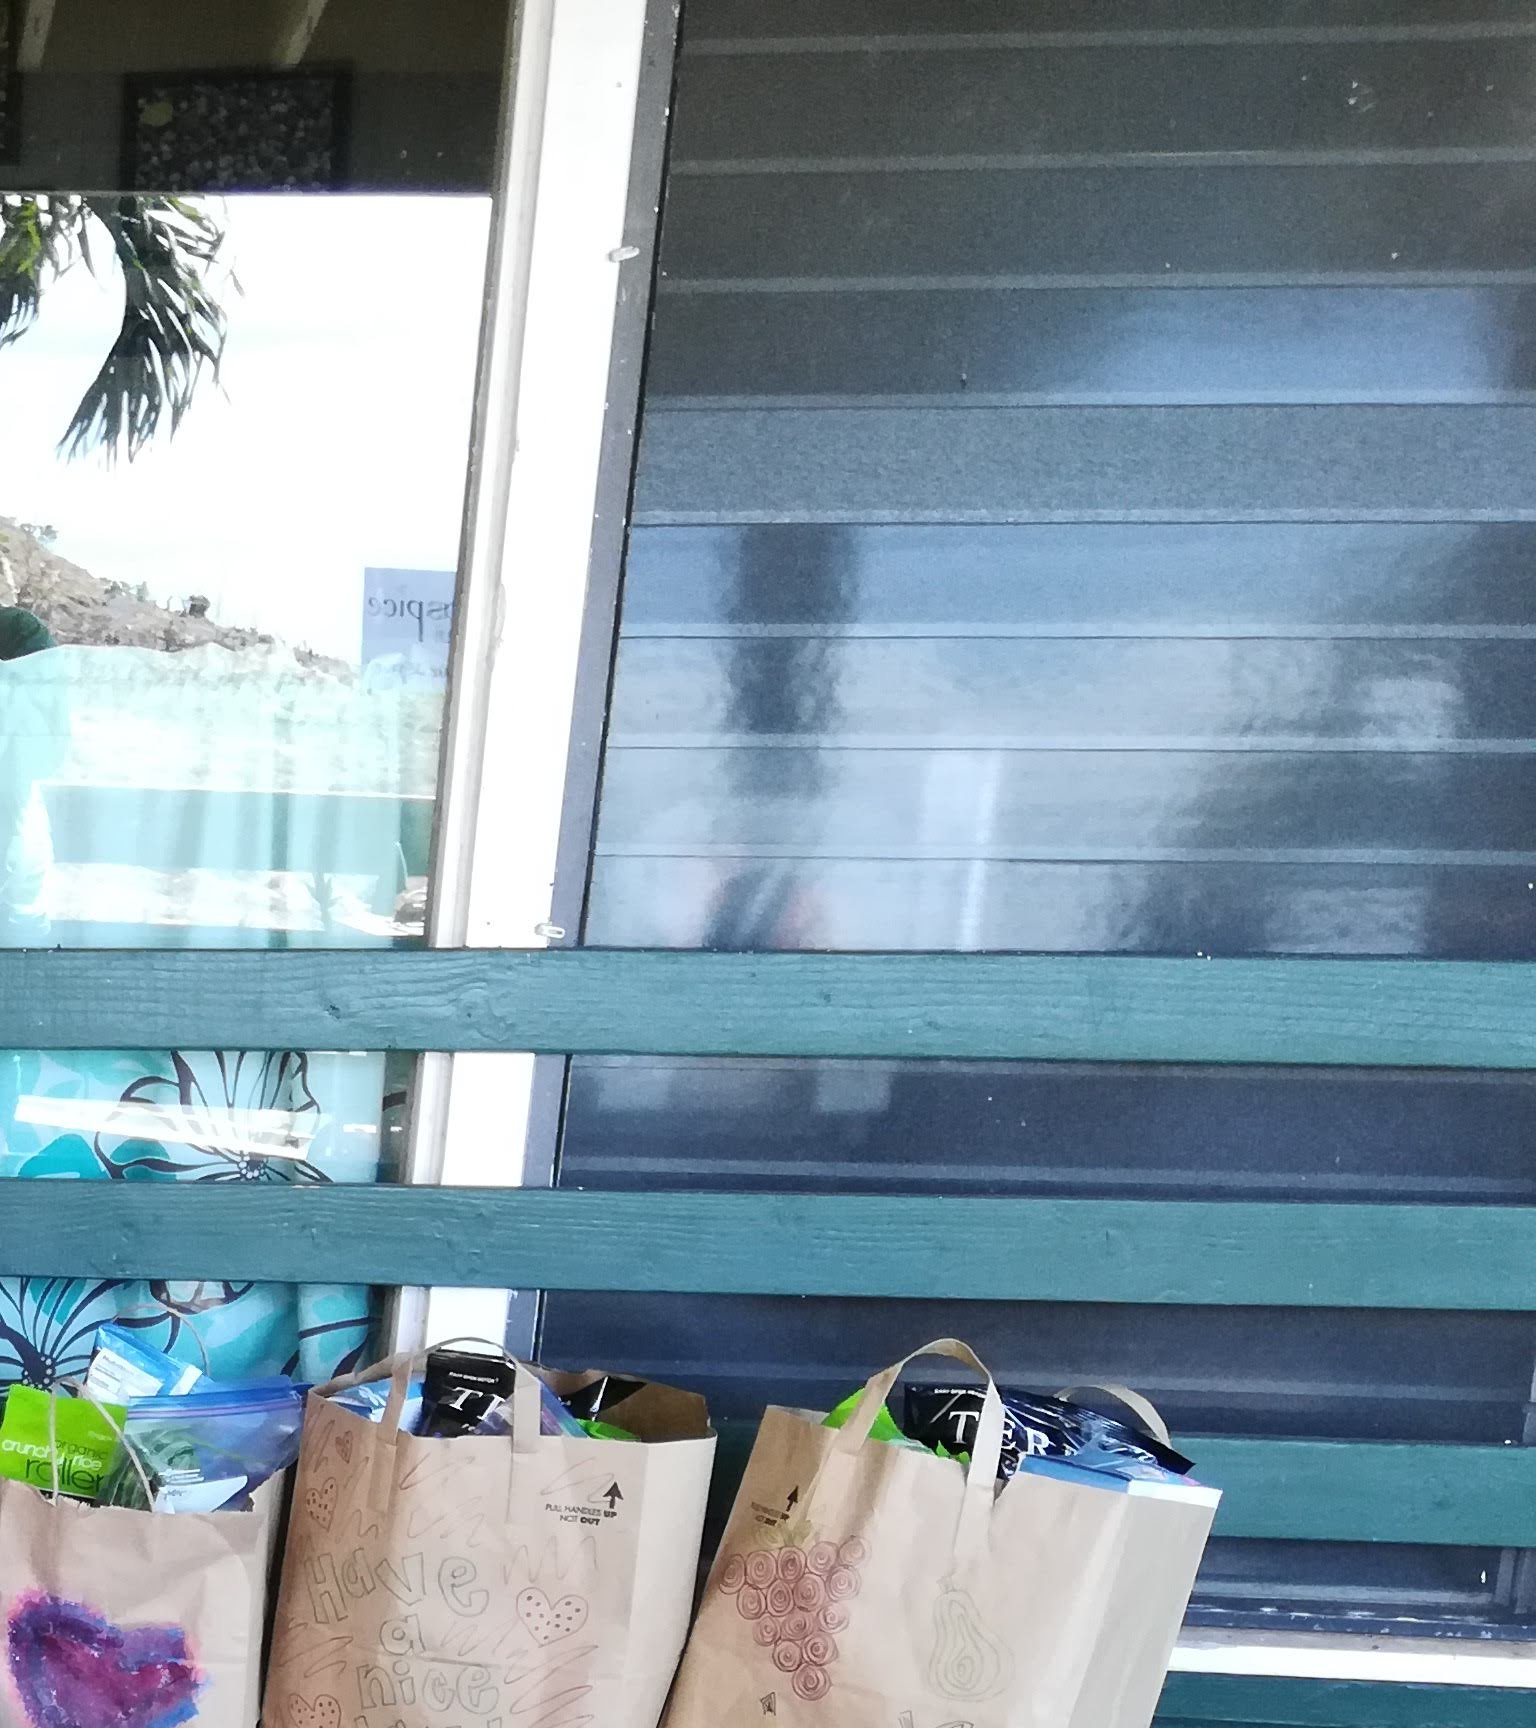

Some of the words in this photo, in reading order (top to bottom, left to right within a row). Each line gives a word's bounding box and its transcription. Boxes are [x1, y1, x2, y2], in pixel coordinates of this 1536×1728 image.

[25, 1457, 105, 1493] roller
[72, 1454, 103, 1472] rice
[559, 1514, 579, 1523] NOT
[579, 1516, 601, 1526] OUT
[603, 1510, 618, 1519] UP
[304, 1547, 491, 1625] Have
[379, 1613, 427, 1656] a
[355, 1658, 500, 1715] nice
